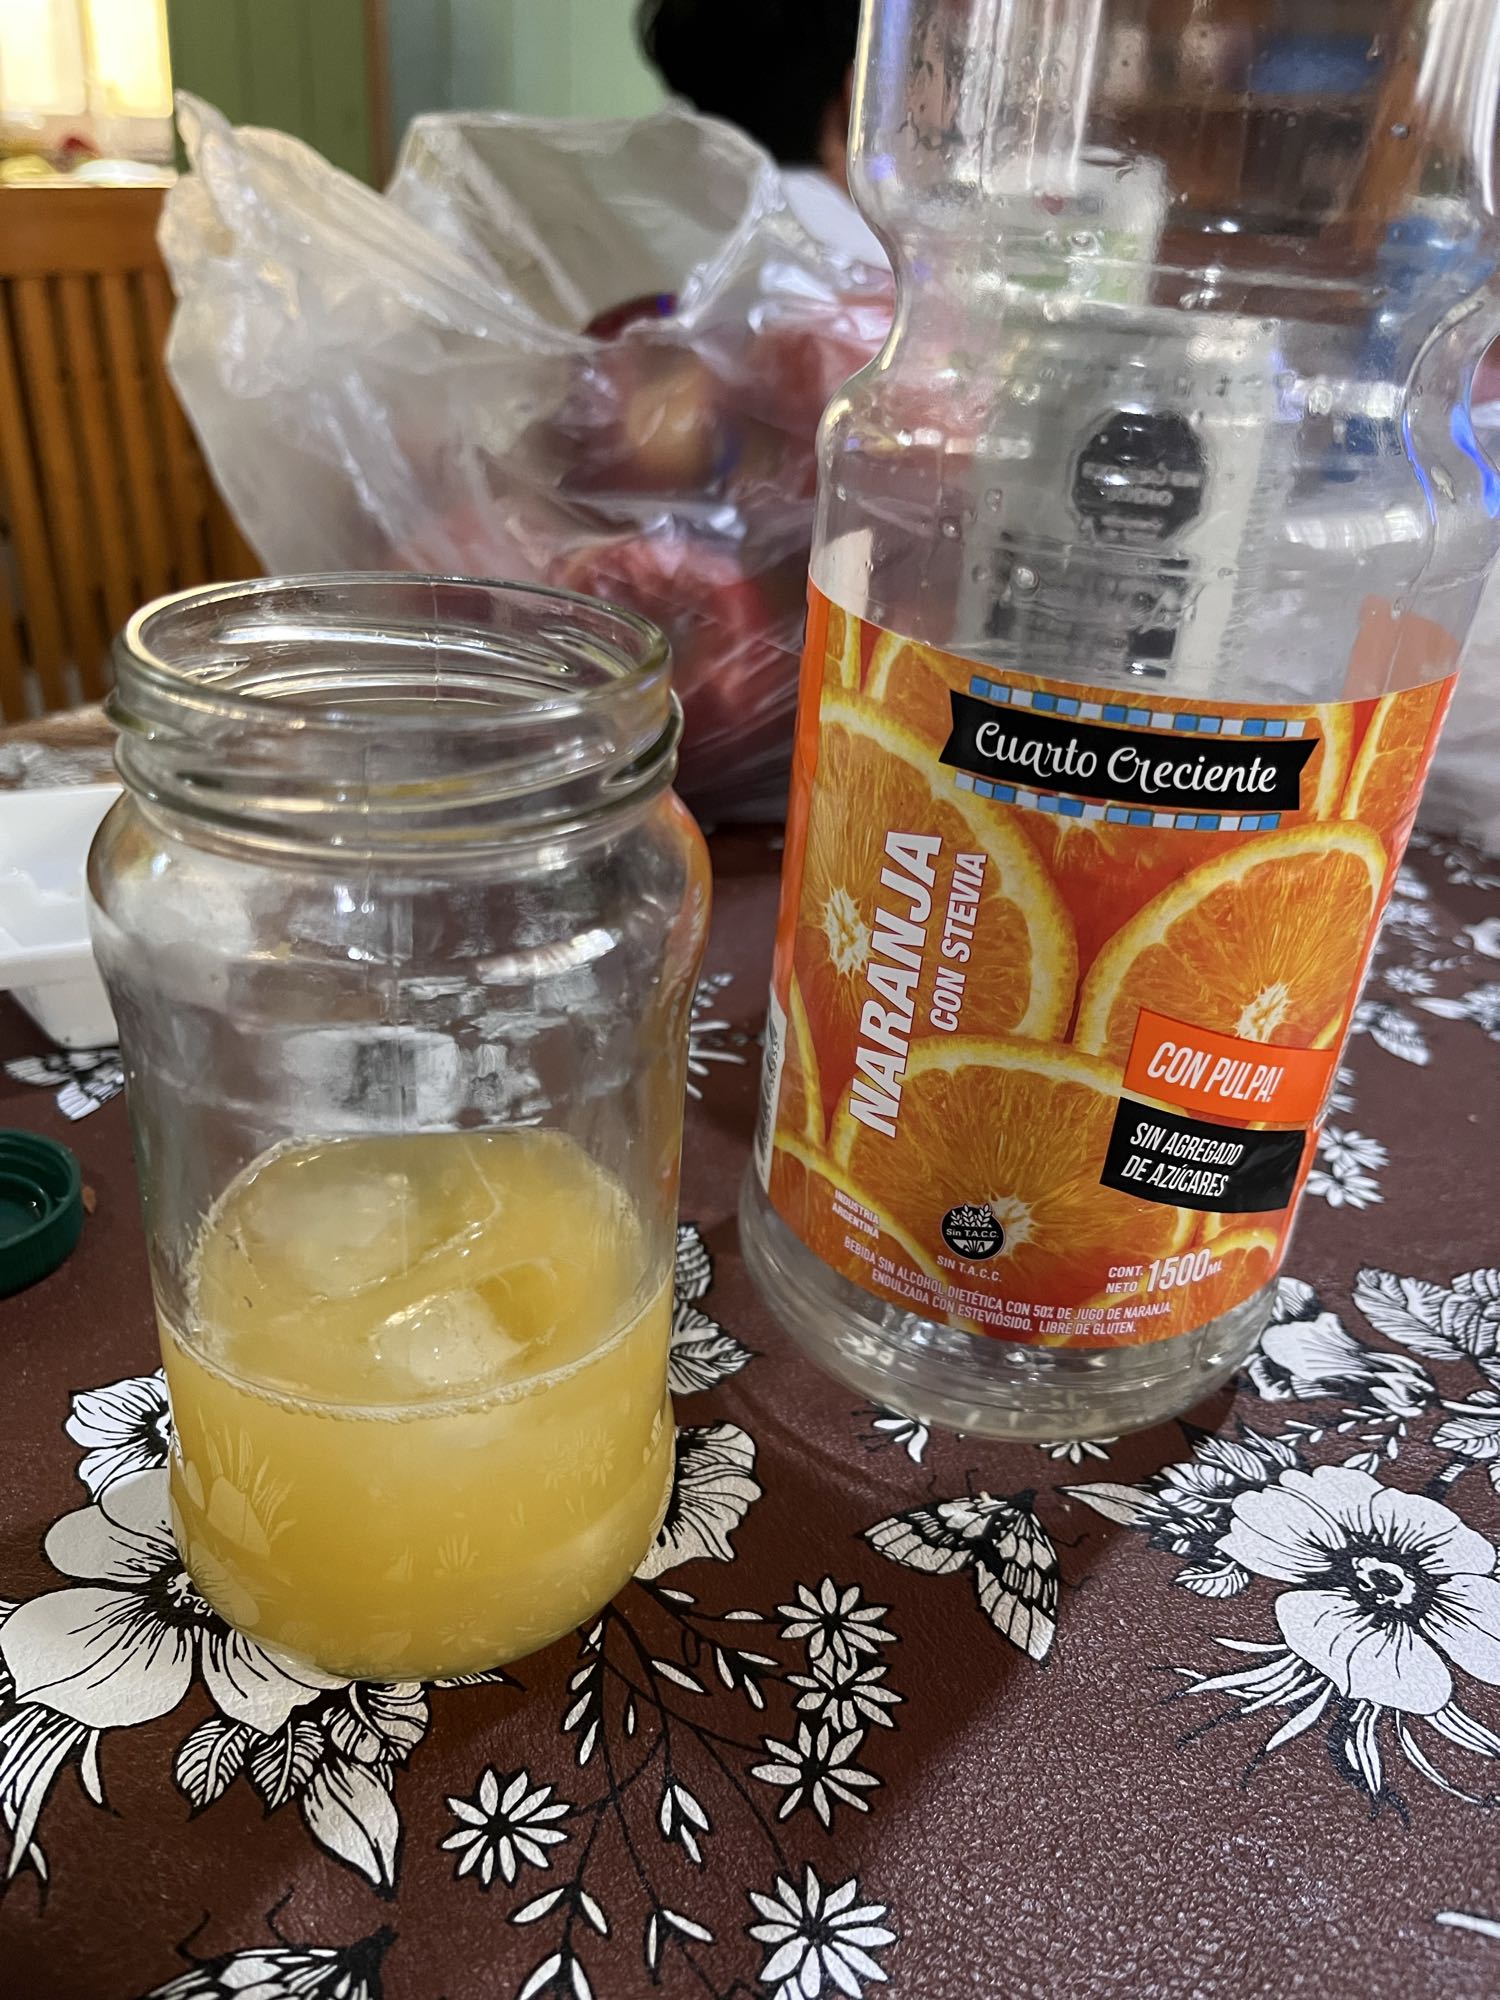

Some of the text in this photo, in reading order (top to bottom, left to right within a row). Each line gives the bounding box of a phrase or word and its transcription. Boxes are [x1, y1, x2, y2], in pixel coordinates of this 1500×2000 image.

[974, 720, 1278, 794] Cuarto Creciente
[930, 852, 988, 1032] CON STEVIA
[849, 830, 942, 1138] NARANJA
[1147, 1041, 1284, 1103] CON PULPA!
[1130, 1122, 1244, 1166] SIN AGREGADO
[1121, 1154, 1229, 1197] DE AZÚCARES
[832, 1202, 880, 1239] ARGENTINA
[834, 1188, 880, 1224] INDUSTRIA
[945, 1228, 962, 1237] Sin
[844, 1235, 876, 1265] BEBIDA
[878, 1256, 896, 1274] SIN
[896, 1265, 945, 1296] ALCOHOL
[947, 1285, 1003, 1311] DIETÉTICA
[1006, 1300, 1030, 1317] CON
[1033, 1304, 1054, 1318] 50%
[1056, 1307, 1073, 1320] DE
[1074, 1308, 1104, 1321] JUGO
[1107, 1307, 1122, 1320] DE
[936, 1254, 1003, 1282] SIN T.A.C.C.
[1105, 1281, 1138, 1294] NETO
[1108, 1265, 1144, 1279] CONT.
[871, 1268, 1137, 1335] ENDULZADA CON ESTEVIÓSIDO. LIBRE DE GLUTEN.
